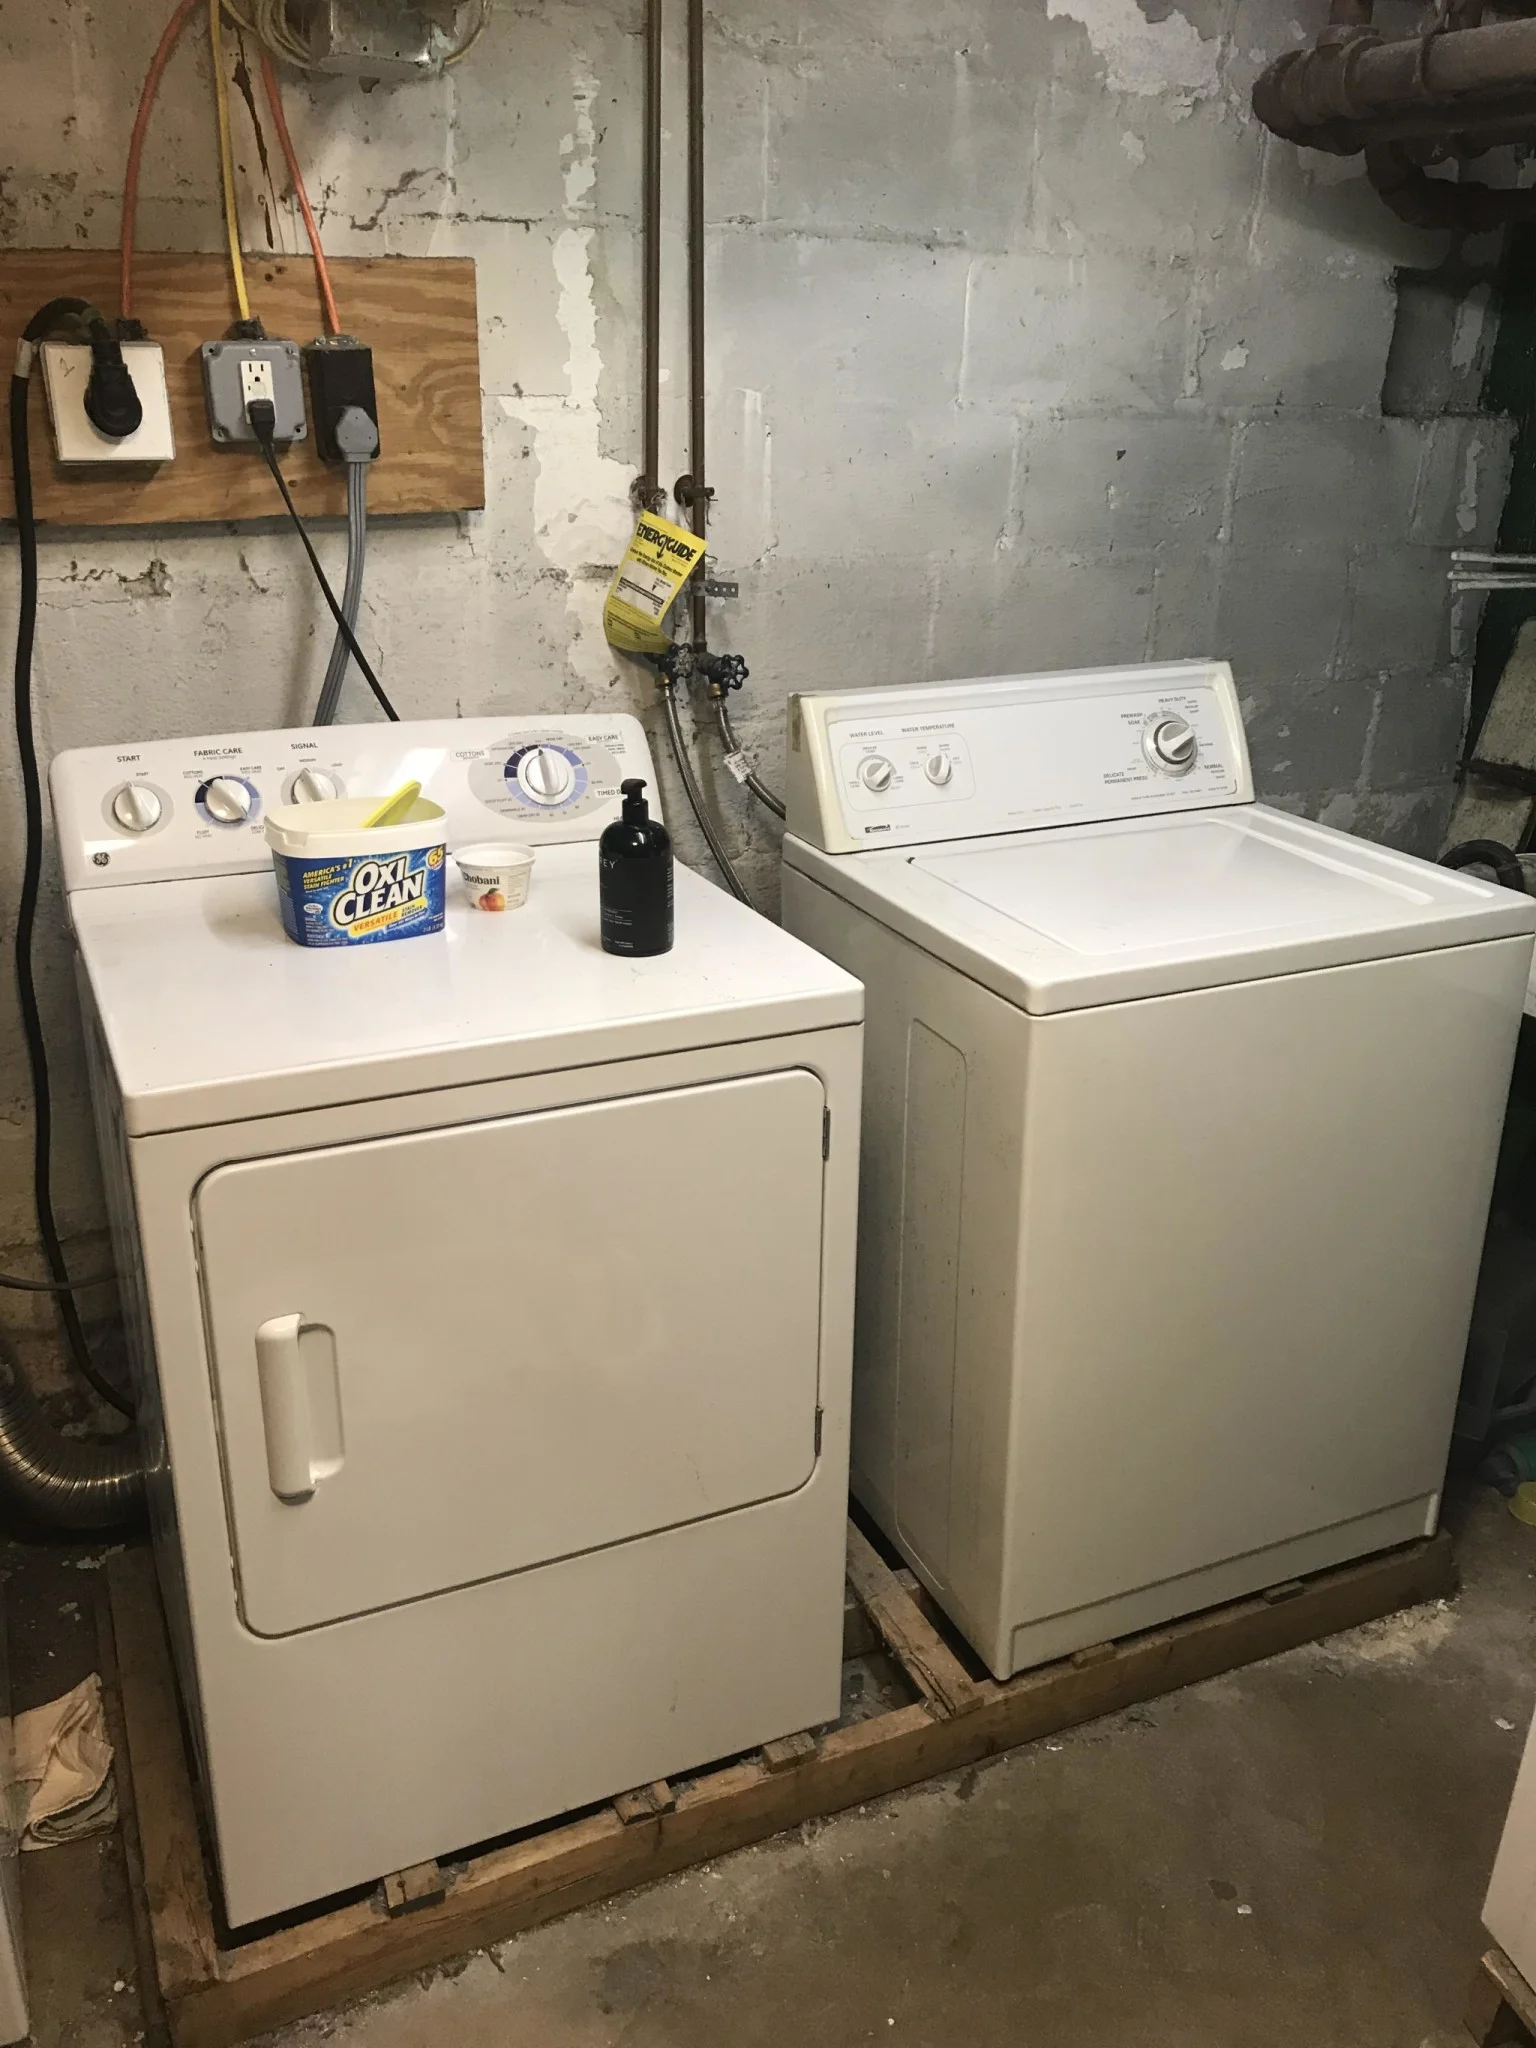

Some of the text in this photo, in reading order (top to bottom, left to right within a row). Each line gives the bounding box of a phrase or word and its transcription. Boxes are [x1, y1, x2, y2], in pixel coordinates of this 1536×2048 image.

[920, 723, 955, 731] TEMPERATURE
[603, 859, 615, 869] EY
[303, 864, 340, 879] AMERICA'S
[353, 856, 407, 895] OXI
[303, 874, 332, 884] VERSATILE
[304, 882, 320, 890] STAIN
[321, 876, 344, 887] FIGHTER
[334, 870, 425, 925] CLEAN
[401, 905, 423, 917] REMOVER
[402, 904, 415, 912] STAIN
[353, 911, 399, 932] VERSATILE
